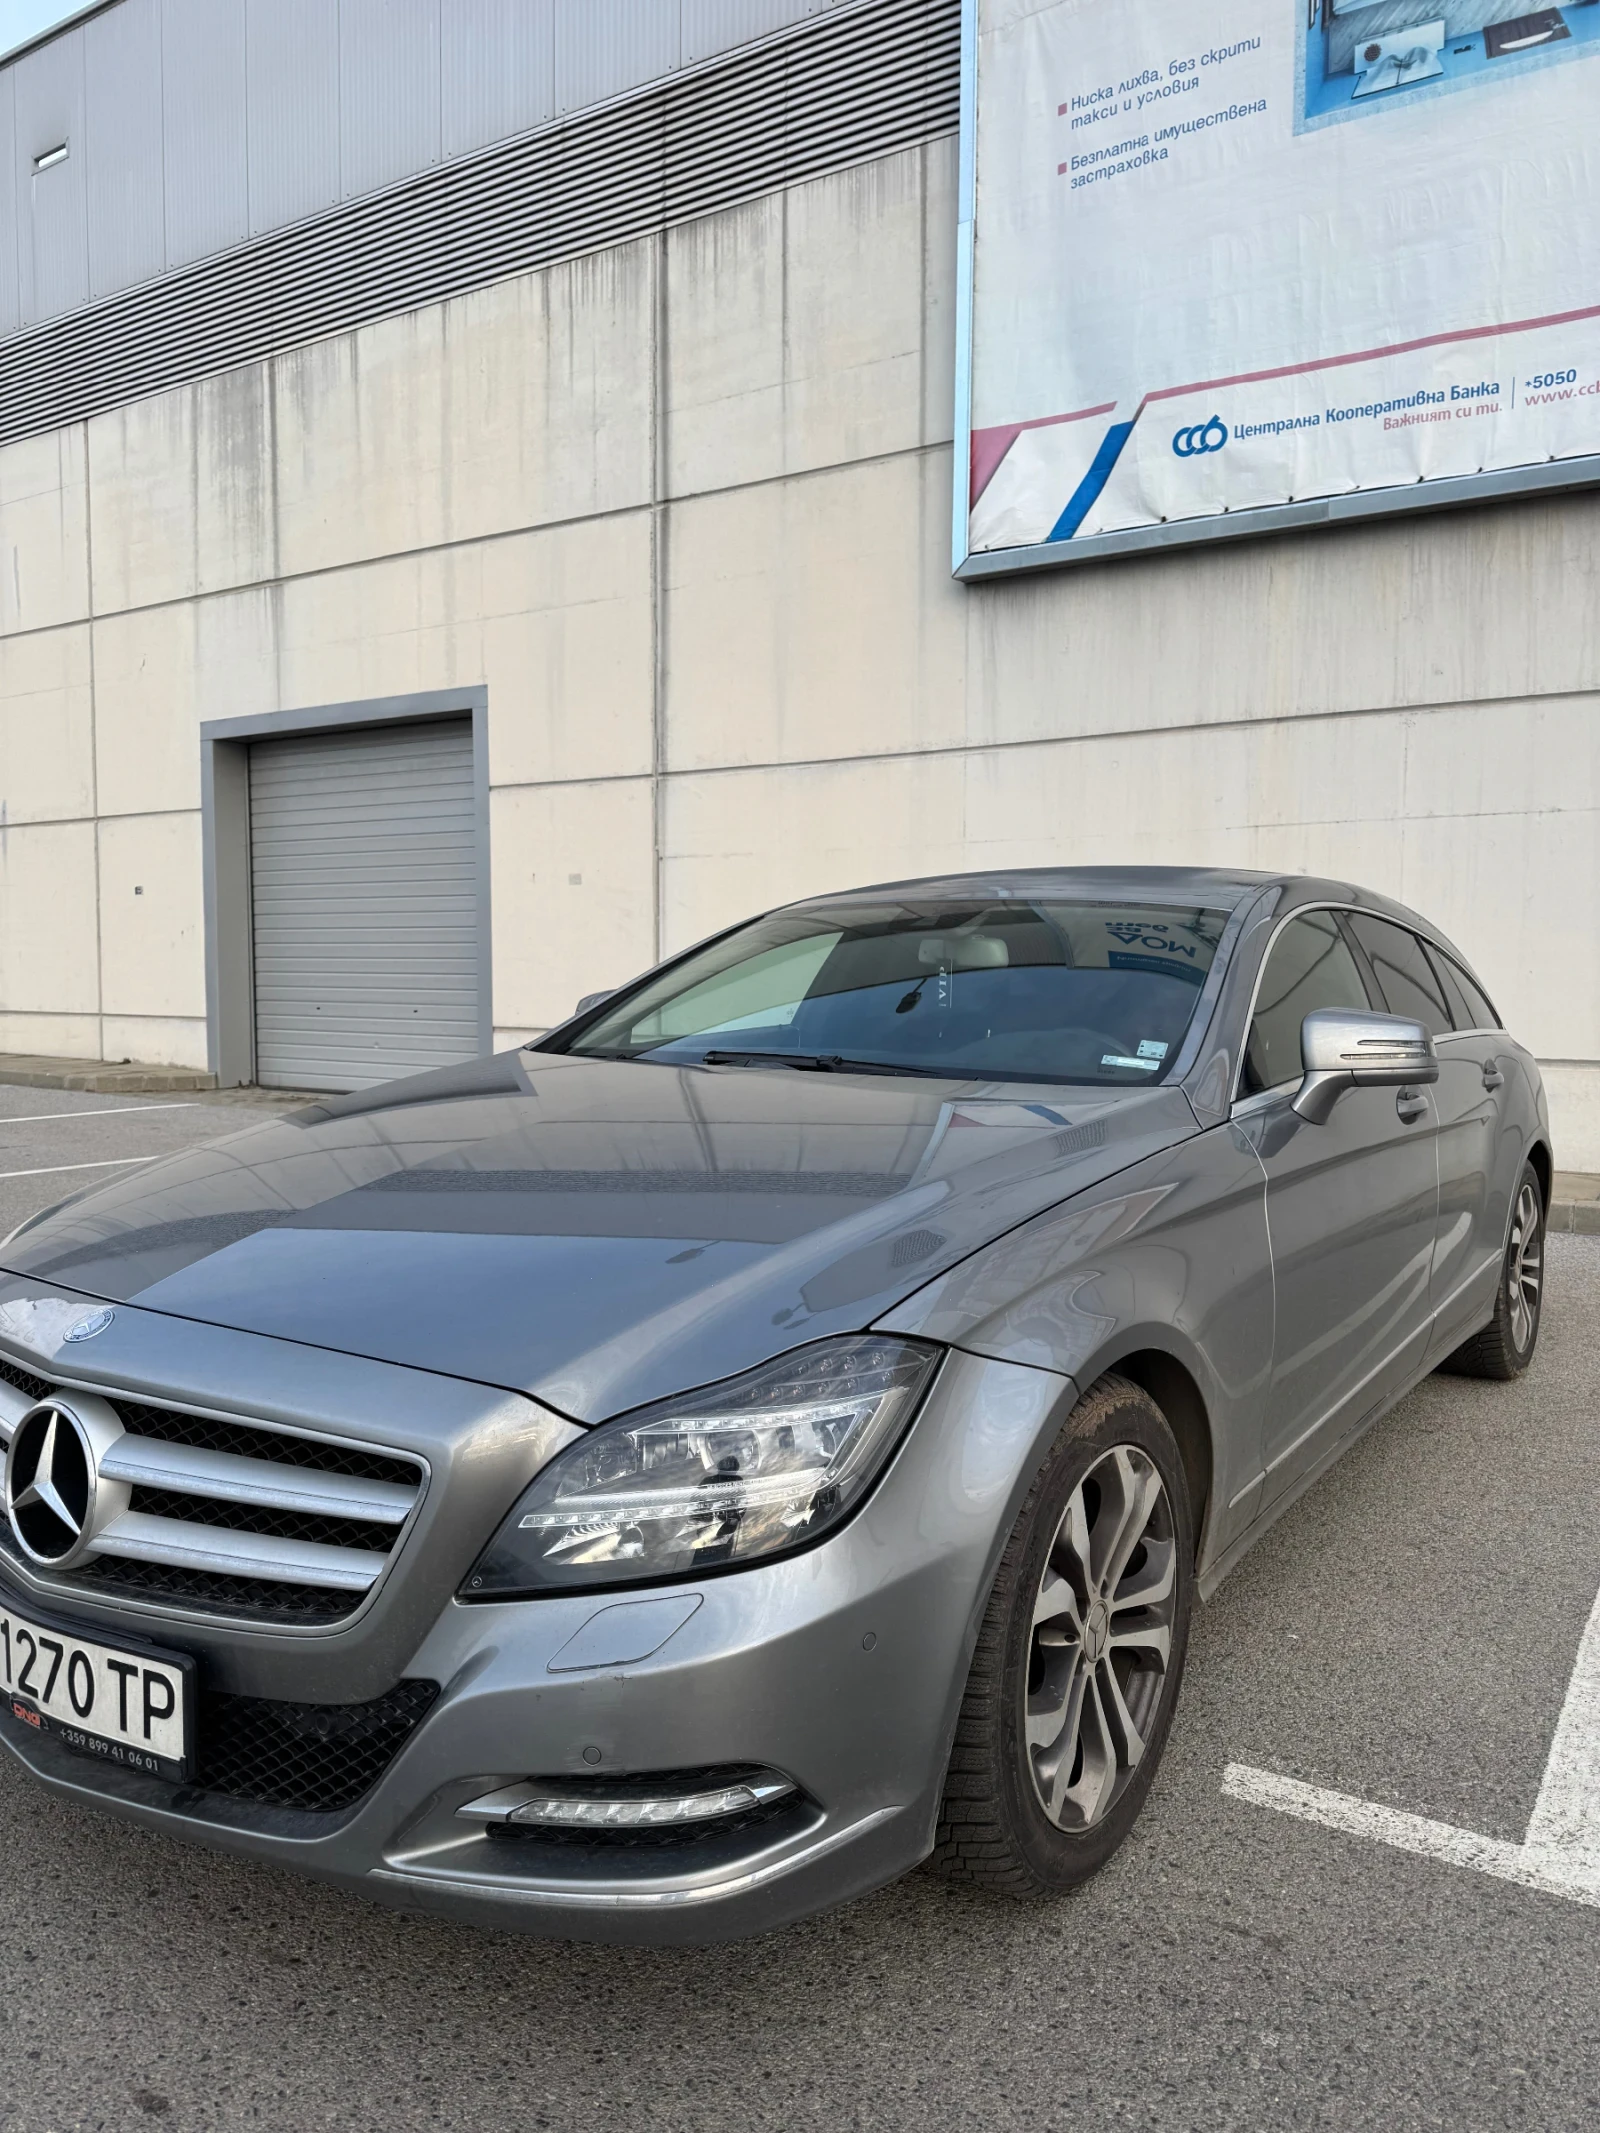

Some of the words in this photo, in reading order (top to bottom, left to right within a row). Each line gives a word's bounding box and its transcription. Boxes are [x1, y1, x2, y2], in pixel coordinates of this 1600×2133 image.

[1071, 88, 1113, 111] Ниска
[1118, 69, 1163, 94] лихва,
[1169, 59, 1195, 76] без
[1200, 36, 1260, 65] скрити
[1071, 104, 1118, 130] такси
[1123, 98, 1132, 110] и
[1137, 77, 1199, 109] условия
[1071, 134, 1149, 171] Безплатна
[1154, 99, 1267, 142] имуществена
[1070, 147, 1169, 189] застраховка
[1234, 414, 1320, 440] Централна
[1326, 390, 1445, 423] Кооперативна
[1450, 381, 1500, 401] Банка
[1383, 409, 1450, 431] Важният
[1455, 407, 1472, 418] си
[1476, 402, 1502, 416] ти.
[0, 1618, 95, 1718] 1270
[107, 1658, 175, 1740] TP
[60, 1728, 86, 1746] +359
[88, 1738, 109, 1754] 899
[112, 1746, 124, 1759] 41
[128, 1751, 142, 1766] 06
[145, 1757, 158, 1771] 01
